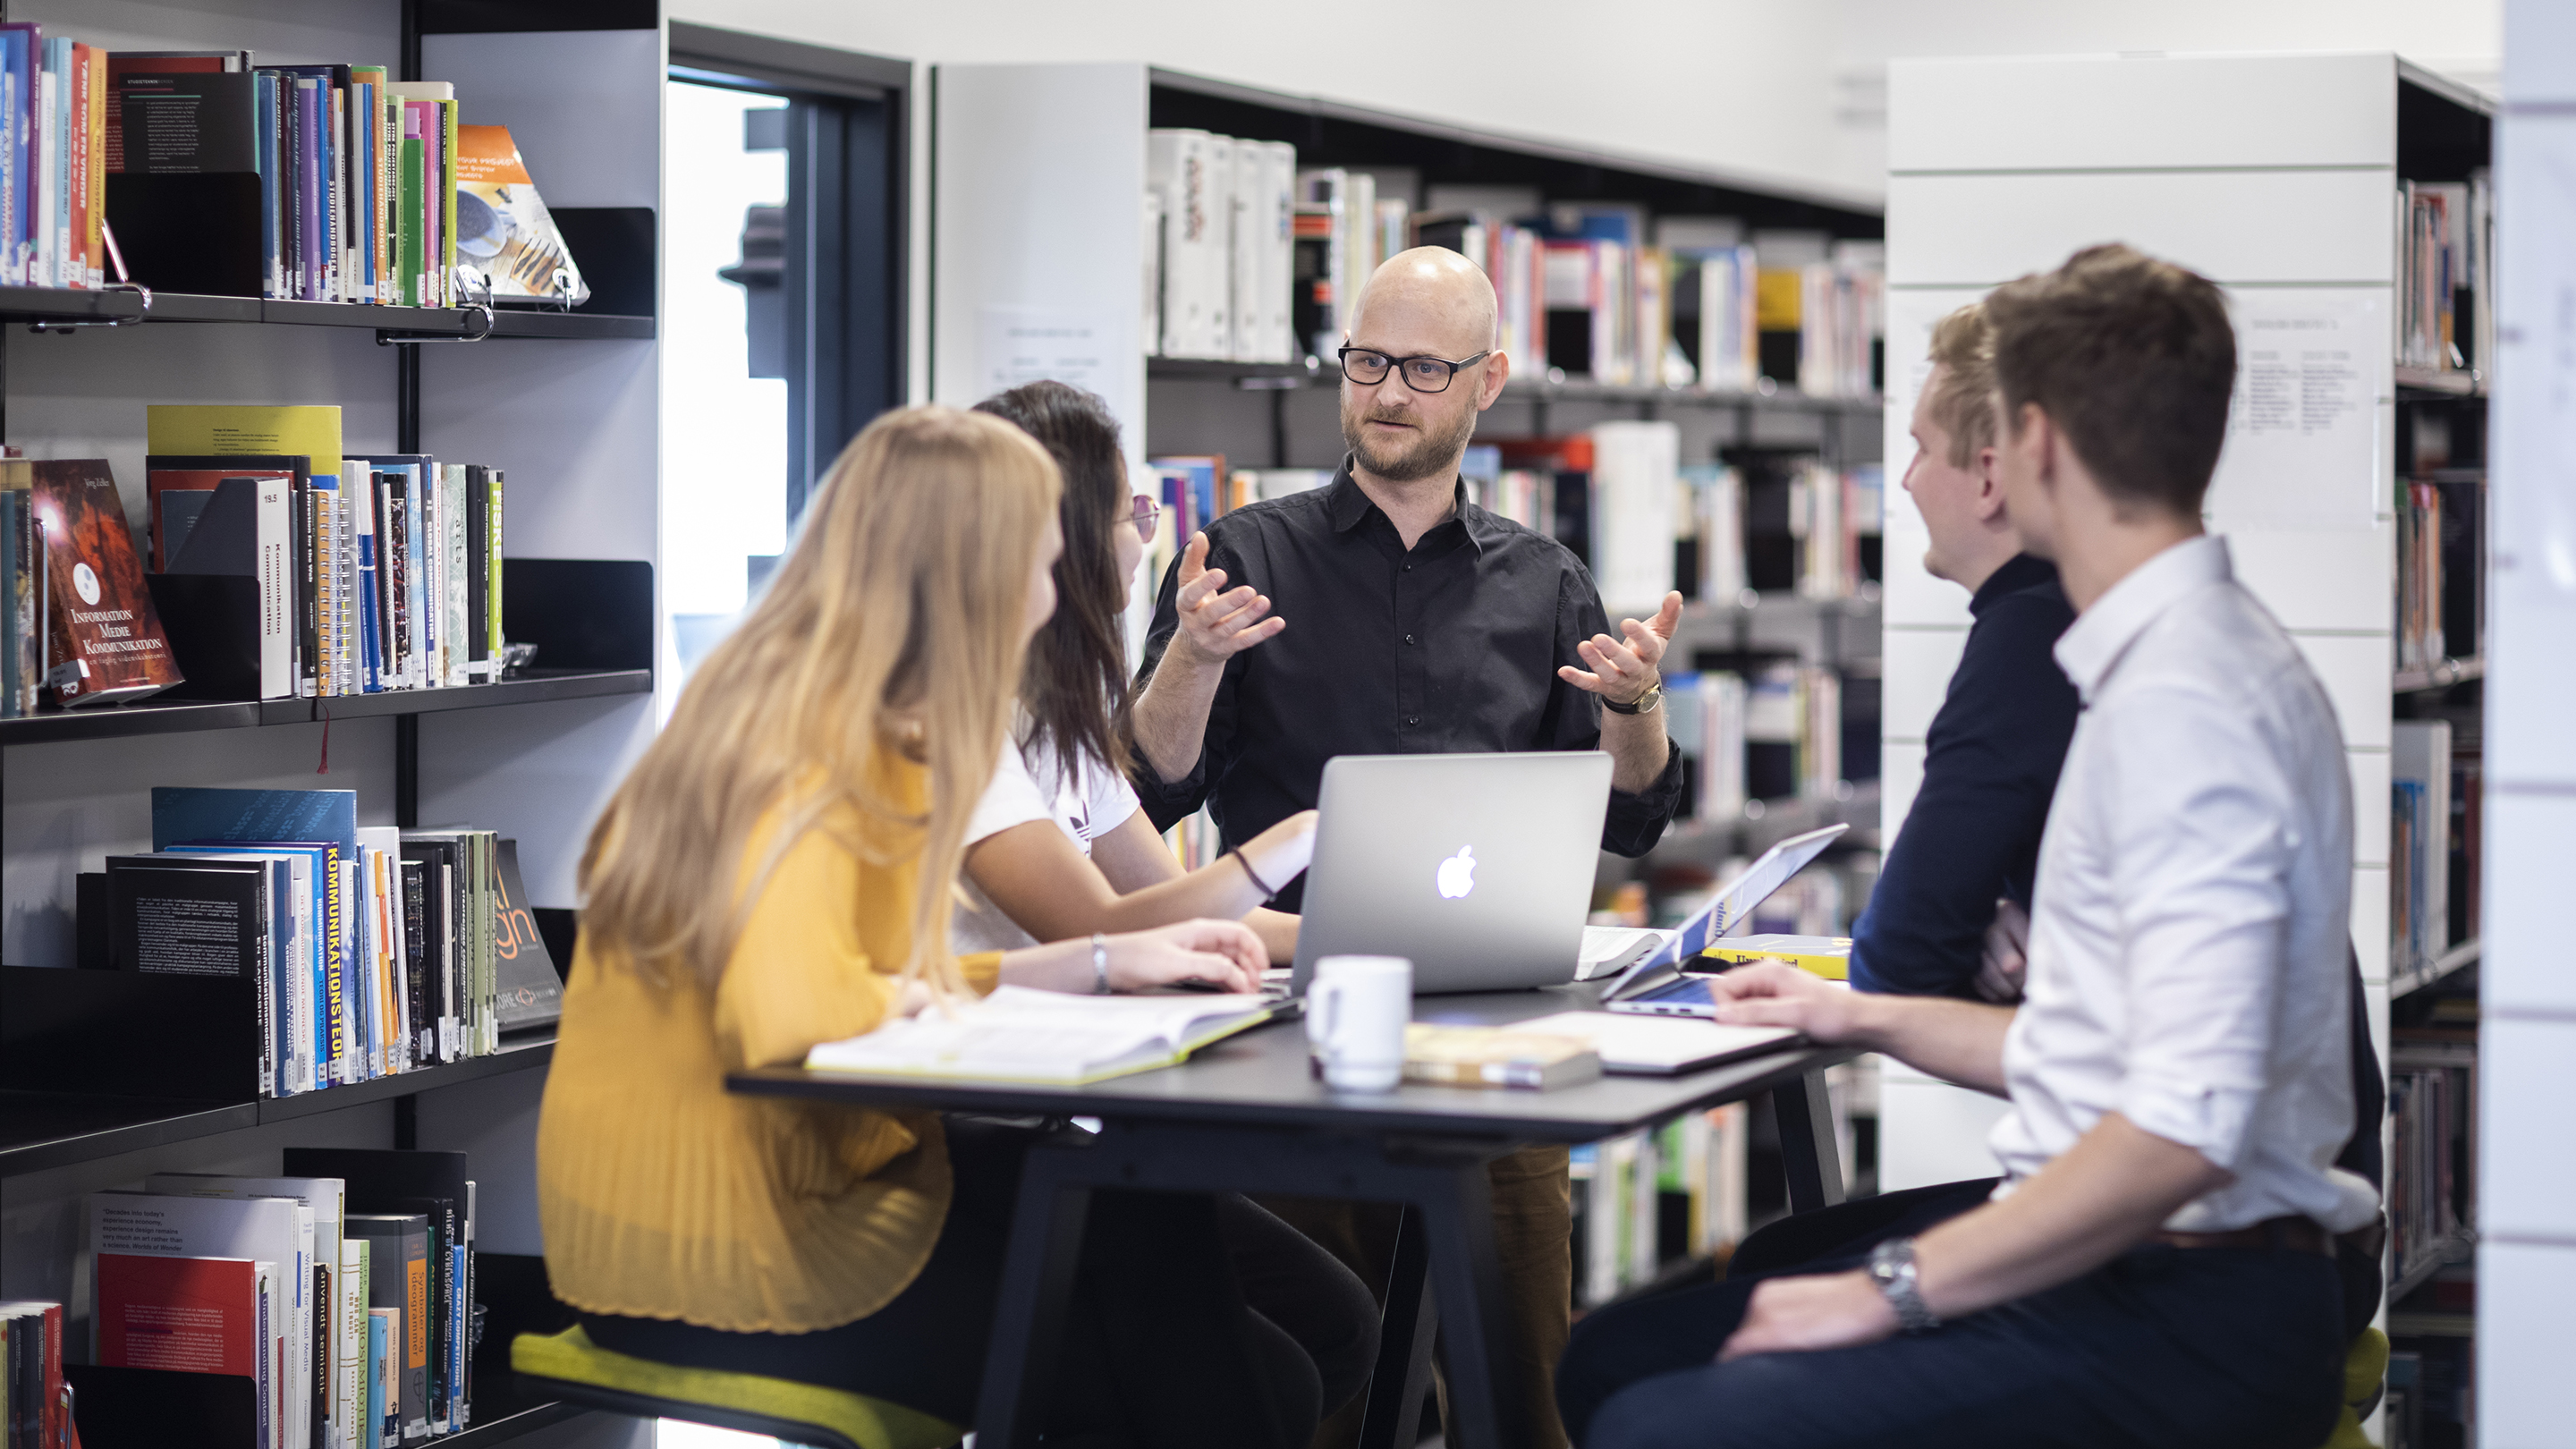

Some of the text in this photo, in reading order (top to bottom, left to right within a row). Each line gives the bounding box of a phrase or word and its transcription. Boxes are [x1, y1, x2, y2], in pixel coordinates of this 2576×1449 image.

[80, 136, 87, 155] EN
[264, 494, 277, 504] 19.5
[493, 489, 502, 561] FISKE
[71, 609, 133, 623] INFORMATION
[98, 623, 131, 639] MEDIE
[83, 639, 163, 655] KOMMUNIKATION
[256, 936, 261, 954] EN
[327, 848, 343, 1065] KOMMUNIKATIONSTEOR
[319, 1004, 325, 1016] OG
[302, 1253, 310, 1290] Writing
[410, 1272, 419, 1356] ideogrammer
[416, 1272, 426, 1353] Symboler og
[302, 1310, 310, 1340] Visual
[302, 1343, 310, 1372] Media
